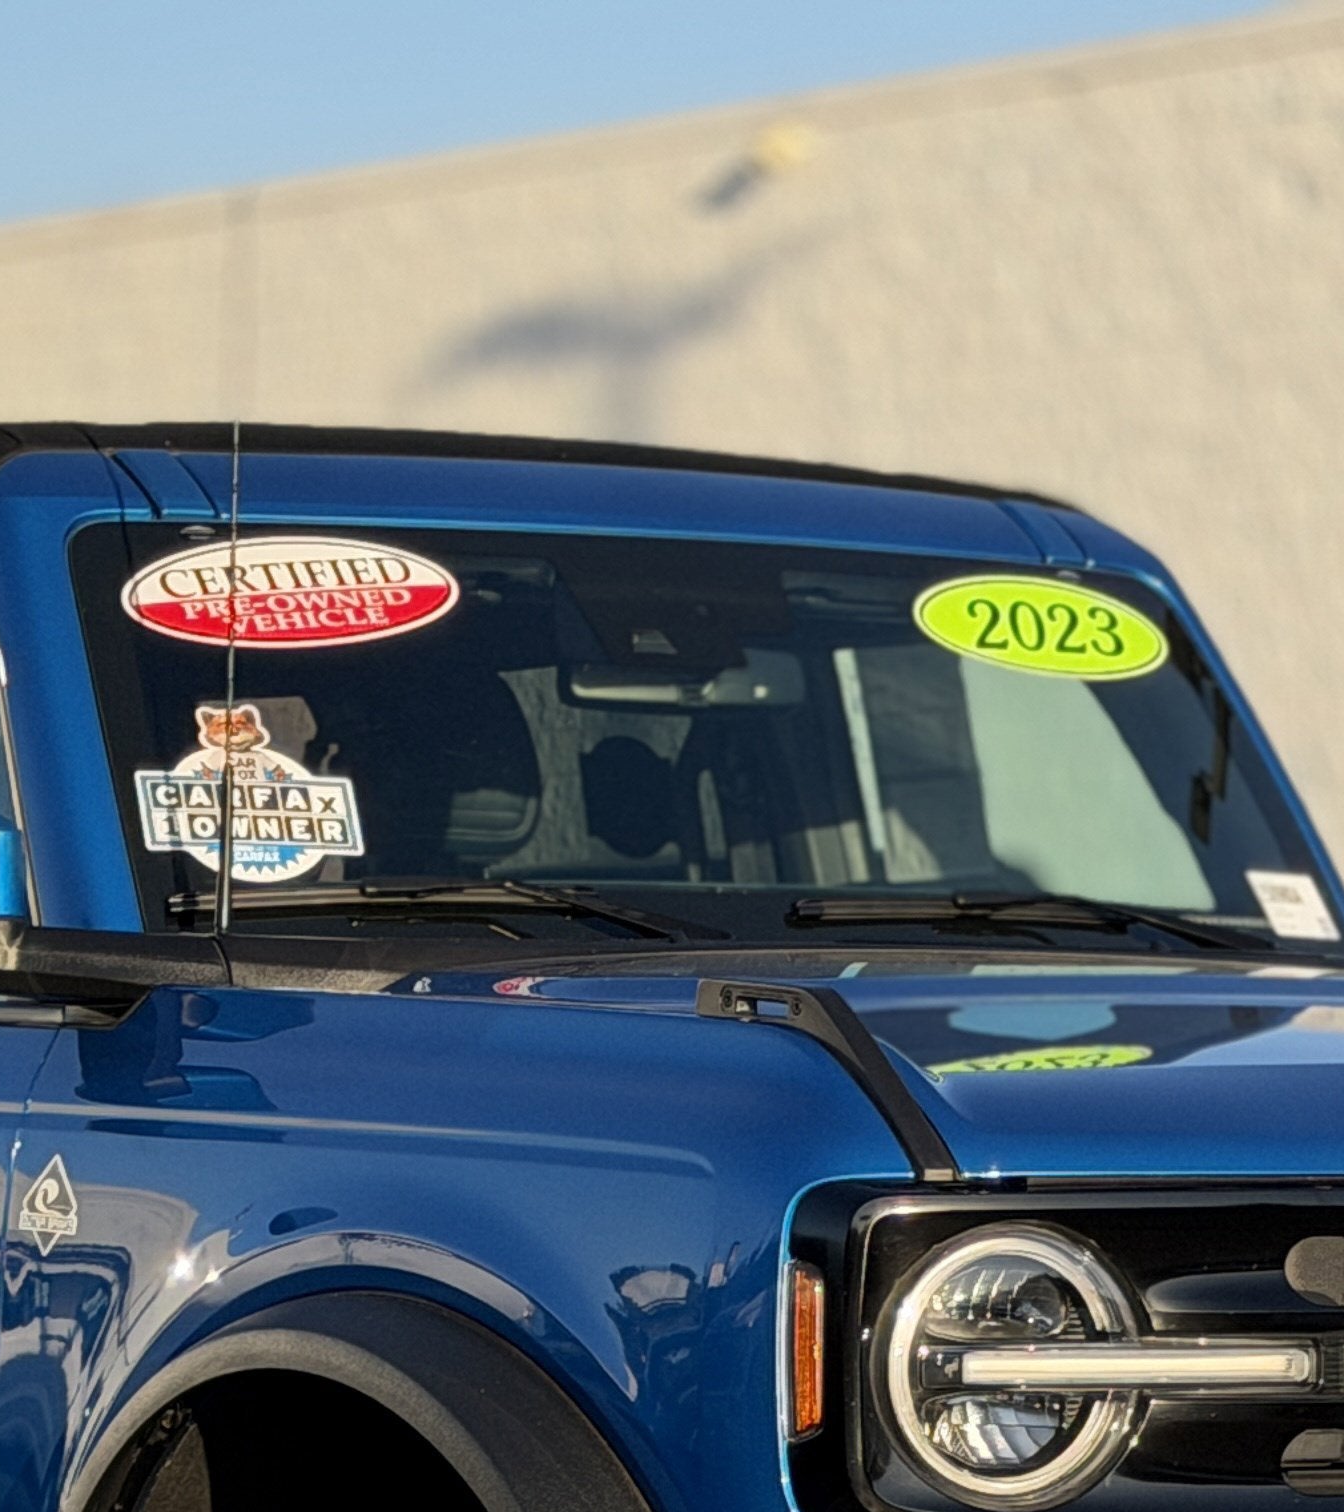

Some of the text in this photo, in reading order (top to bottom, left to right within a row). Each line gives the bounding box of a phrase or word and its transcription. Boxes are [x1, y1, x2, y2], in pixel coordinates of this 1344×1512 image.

[160, 557, 412, 598] CERTIFIED
[180, 588, 412, 621] PRE-OWNED
[223, 606, 389, 635] VEHICLE
[967, 599, 1124, 657] 2023
[155, 785, 337, 815] CARFAX
[192, 816, 344, 842] OWNER
